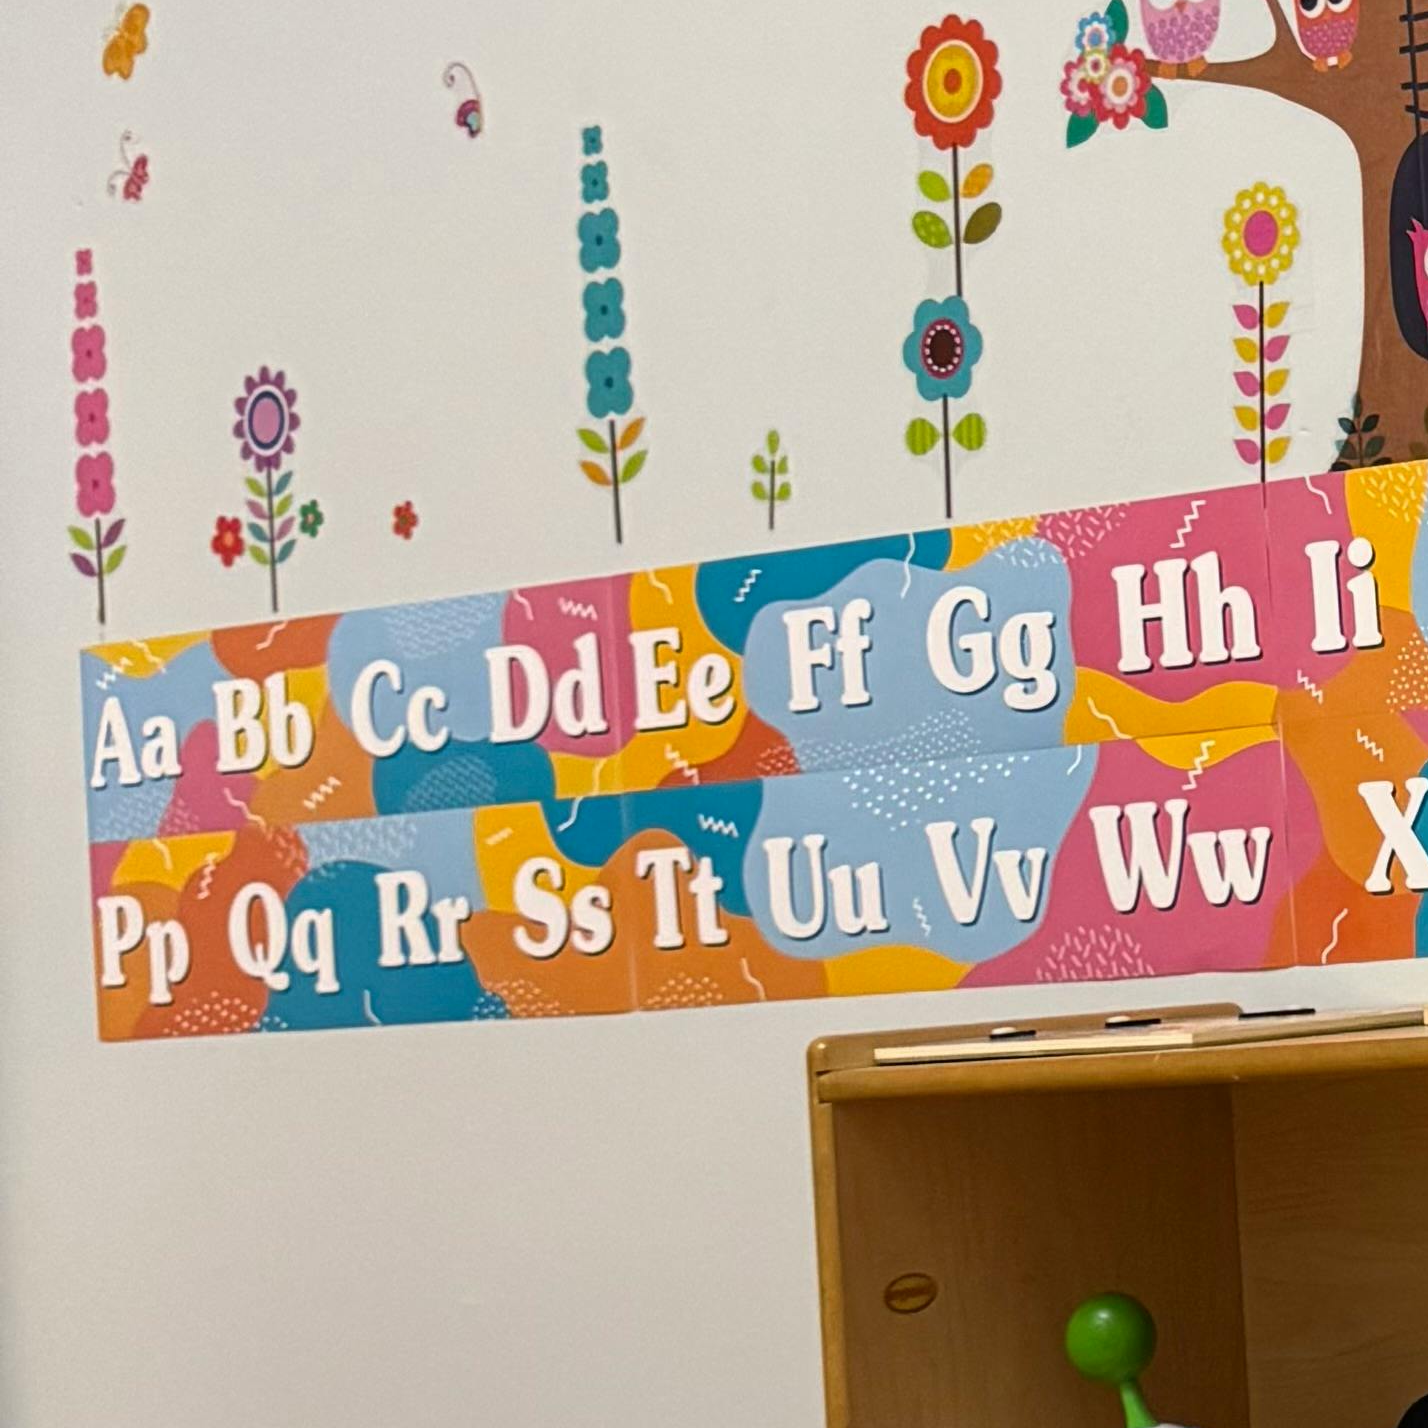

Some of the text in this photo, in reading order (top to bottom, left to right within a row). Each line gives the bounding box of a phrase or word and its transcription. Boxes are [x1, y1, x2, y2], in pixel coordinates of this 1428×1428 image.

[92, 696, 183, 788] Aa
[214, 672, 314, 772] Bb
[352, 659, 449, 757] Cc
[487, 633, 606, 744] Dd
[631, 627, 736, 731] Ee
[784, 598, 873, 712] Ff
[926, 586, 1058, 711] Gg
[1111, 551, 1261, 673] Hh
[1304, 537, 1383, 652] Ii
[98, 894, 189, 1005] Pp
[228, 882, 341, 992] Qq
[377, 870, 471, 968] Rr
[513, 856, 614, 958] Ss
[637, 844, 729, 950] Tt
[765, 834, 887, 939] Uu
[926, 817, 1047, 925] Vv
[1089, 799, 1271, 913] Ww
